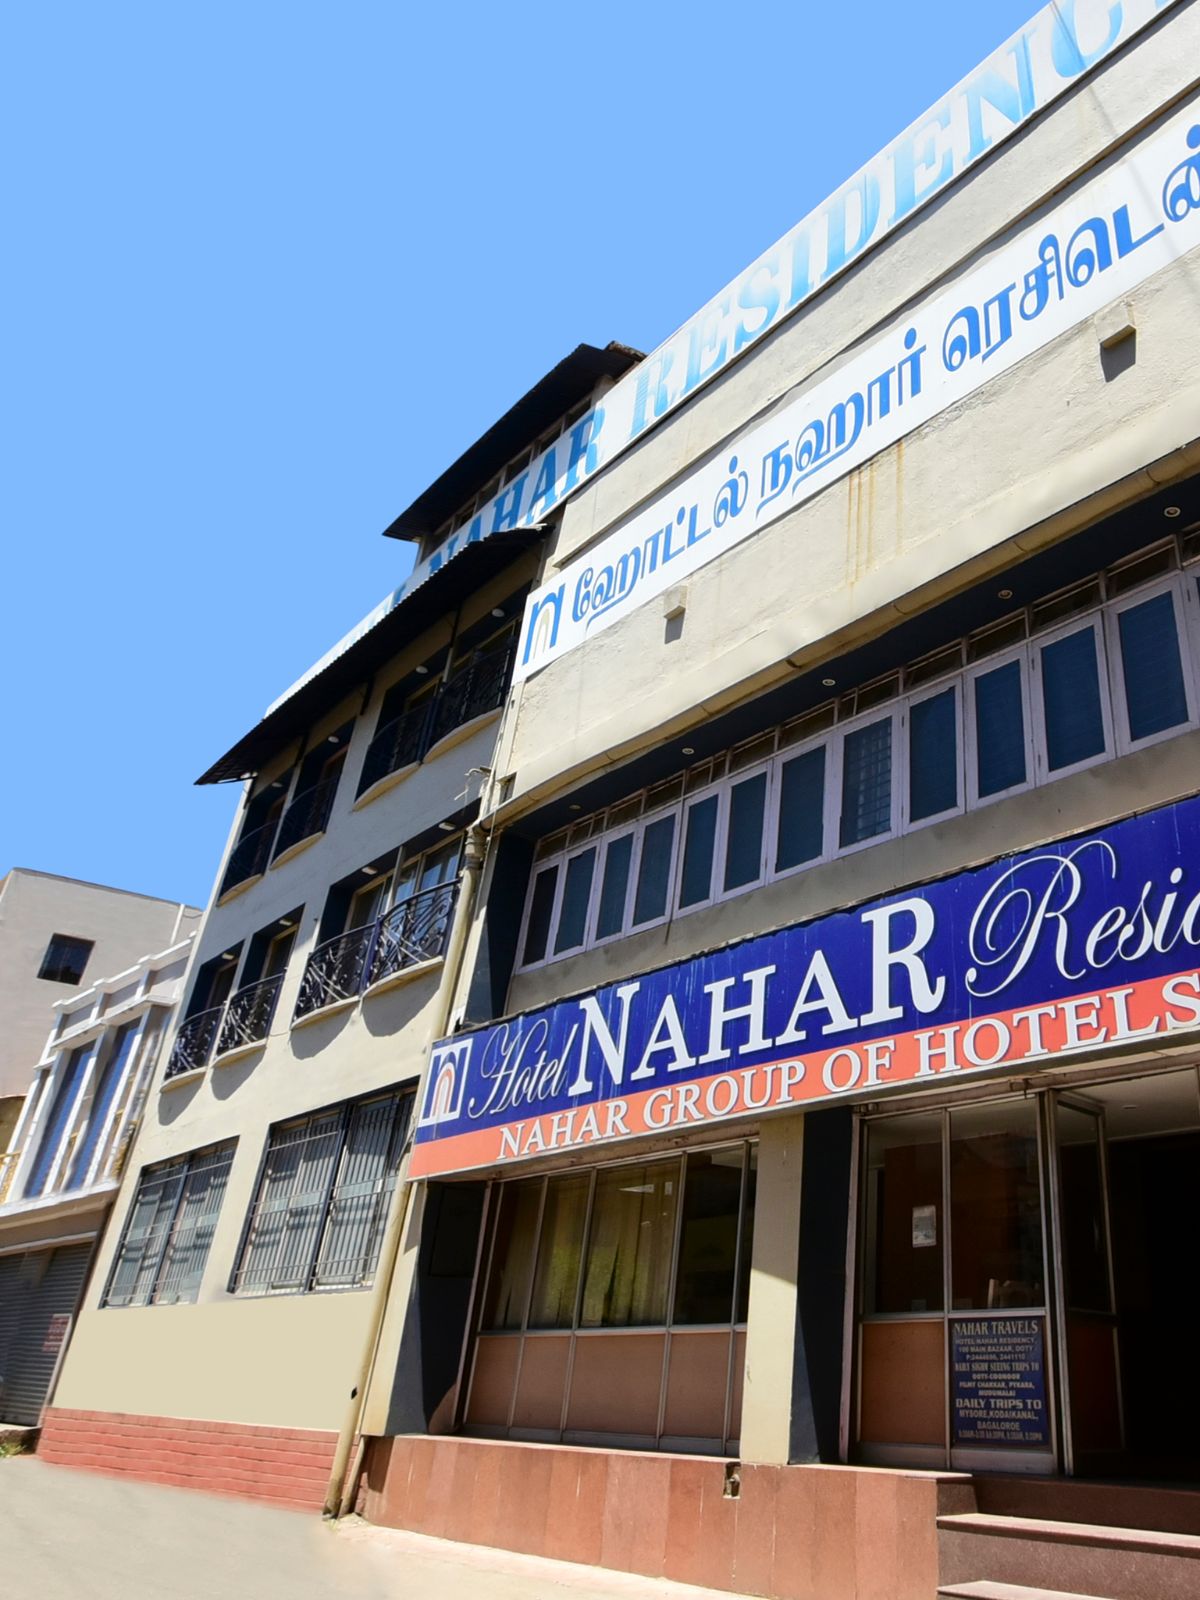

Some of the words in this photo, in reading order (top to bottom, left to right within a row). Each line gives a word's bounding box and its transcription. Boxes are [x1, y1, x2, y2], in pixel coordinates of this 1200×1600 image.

[630, 0, 1182, 440] RESIDENC
[755, 327, 927, 521] நஹார்
[467, 1018, 579, 1118] Hotel
[568, 897, 946, 1097] NAHAR
[496, 1099, 631, 1160] NAHAR
[643, 1059, 807, 1130] GROUP
[821, 1040, 897, 1092] OF
[954, 1322, 989, 1336] NAHAR
[991, 1320, 1039, 1335] TRAVELS
[955, 1398, 986, 1409] DAILY
[989, 1398, 1023, 1409] TRIPS
[1025, 1399, 1042, 1410] TO
